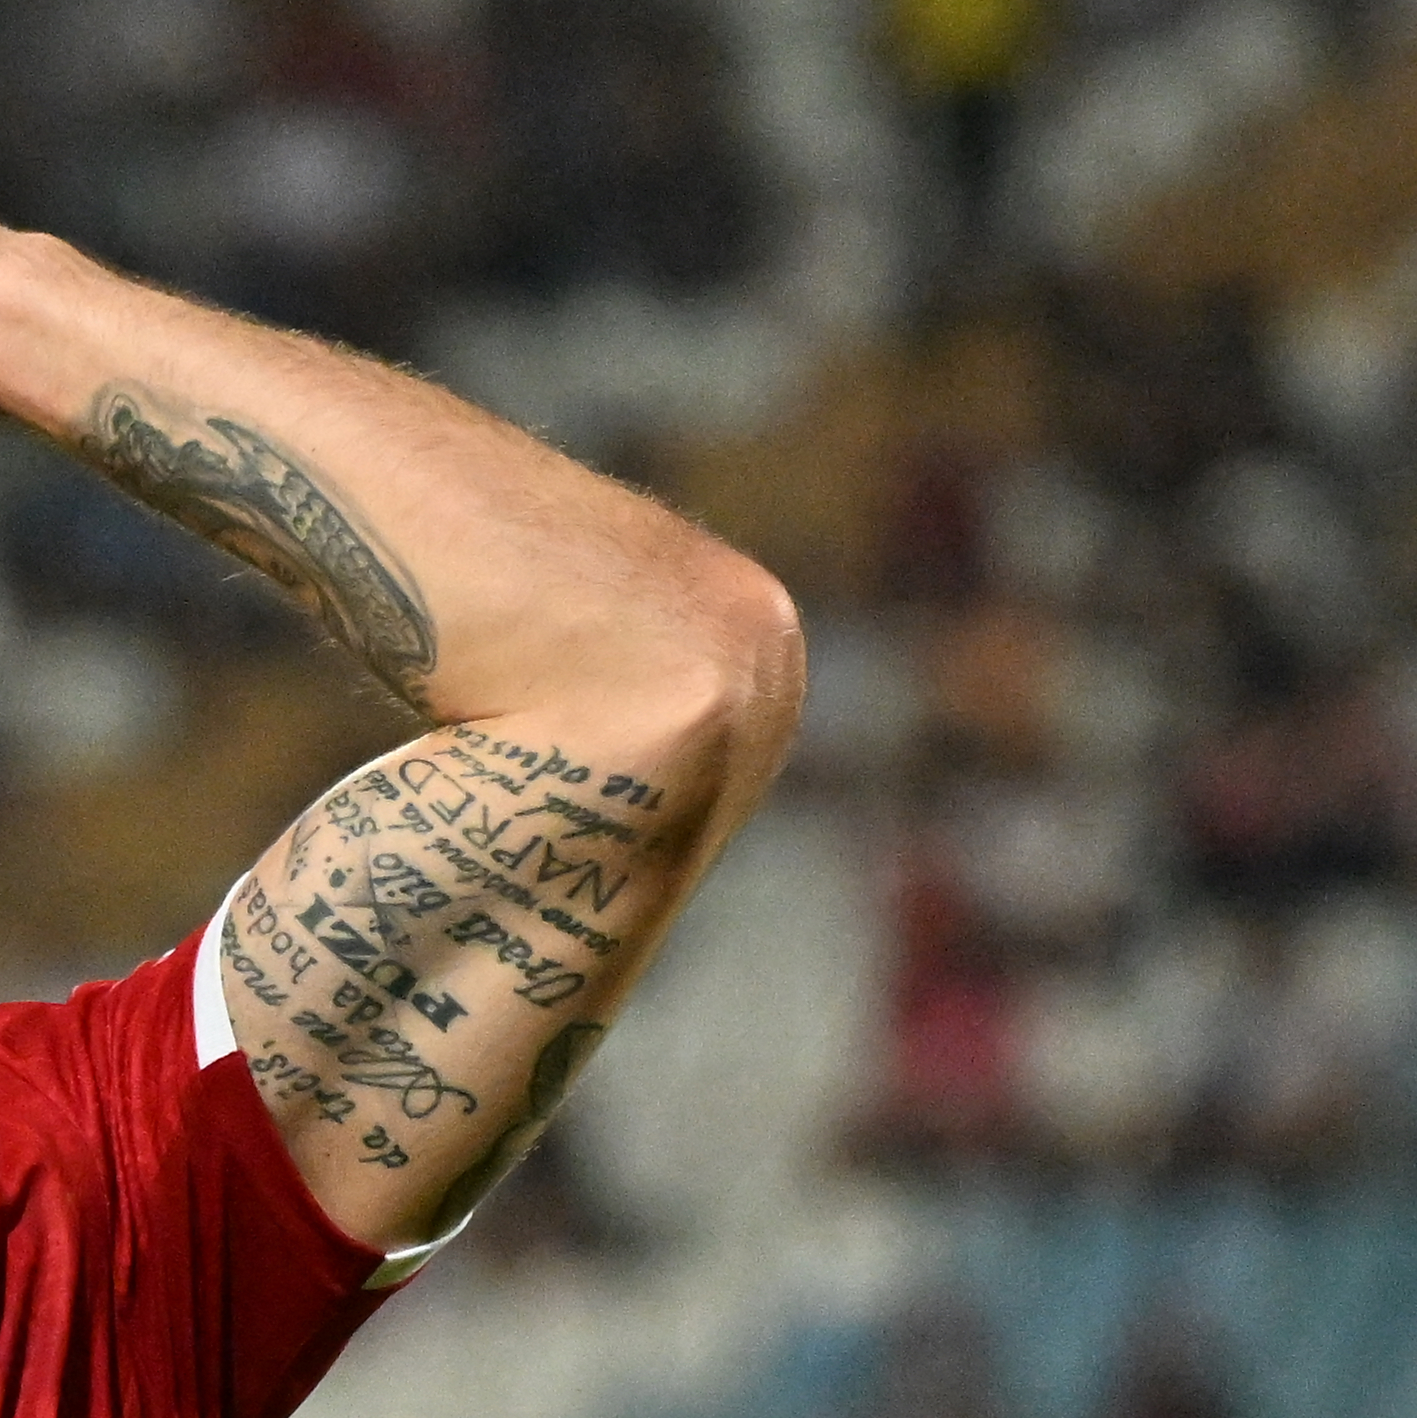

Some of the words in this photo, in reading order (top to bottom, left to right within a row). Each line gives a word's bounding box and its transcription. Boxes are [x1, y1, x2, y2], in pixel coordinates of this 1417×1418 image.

[446, 725, 589, 783] odusta
[389, 802, 433, 835] da
[399, 757, 627, 912] NAPRED
[371, 851, 450, 916] bilo
[220, 910, 288, 1006] može
[294, 893, 469, 1033] PUZI
[445, 912, 584, 1006] Uradi
[291, 1009, 348, 1046] ne
[331, 980, 382, 1022] da
[338, 1029, 477, 1118] Ako
[359, 1125, 410, 1168] da
